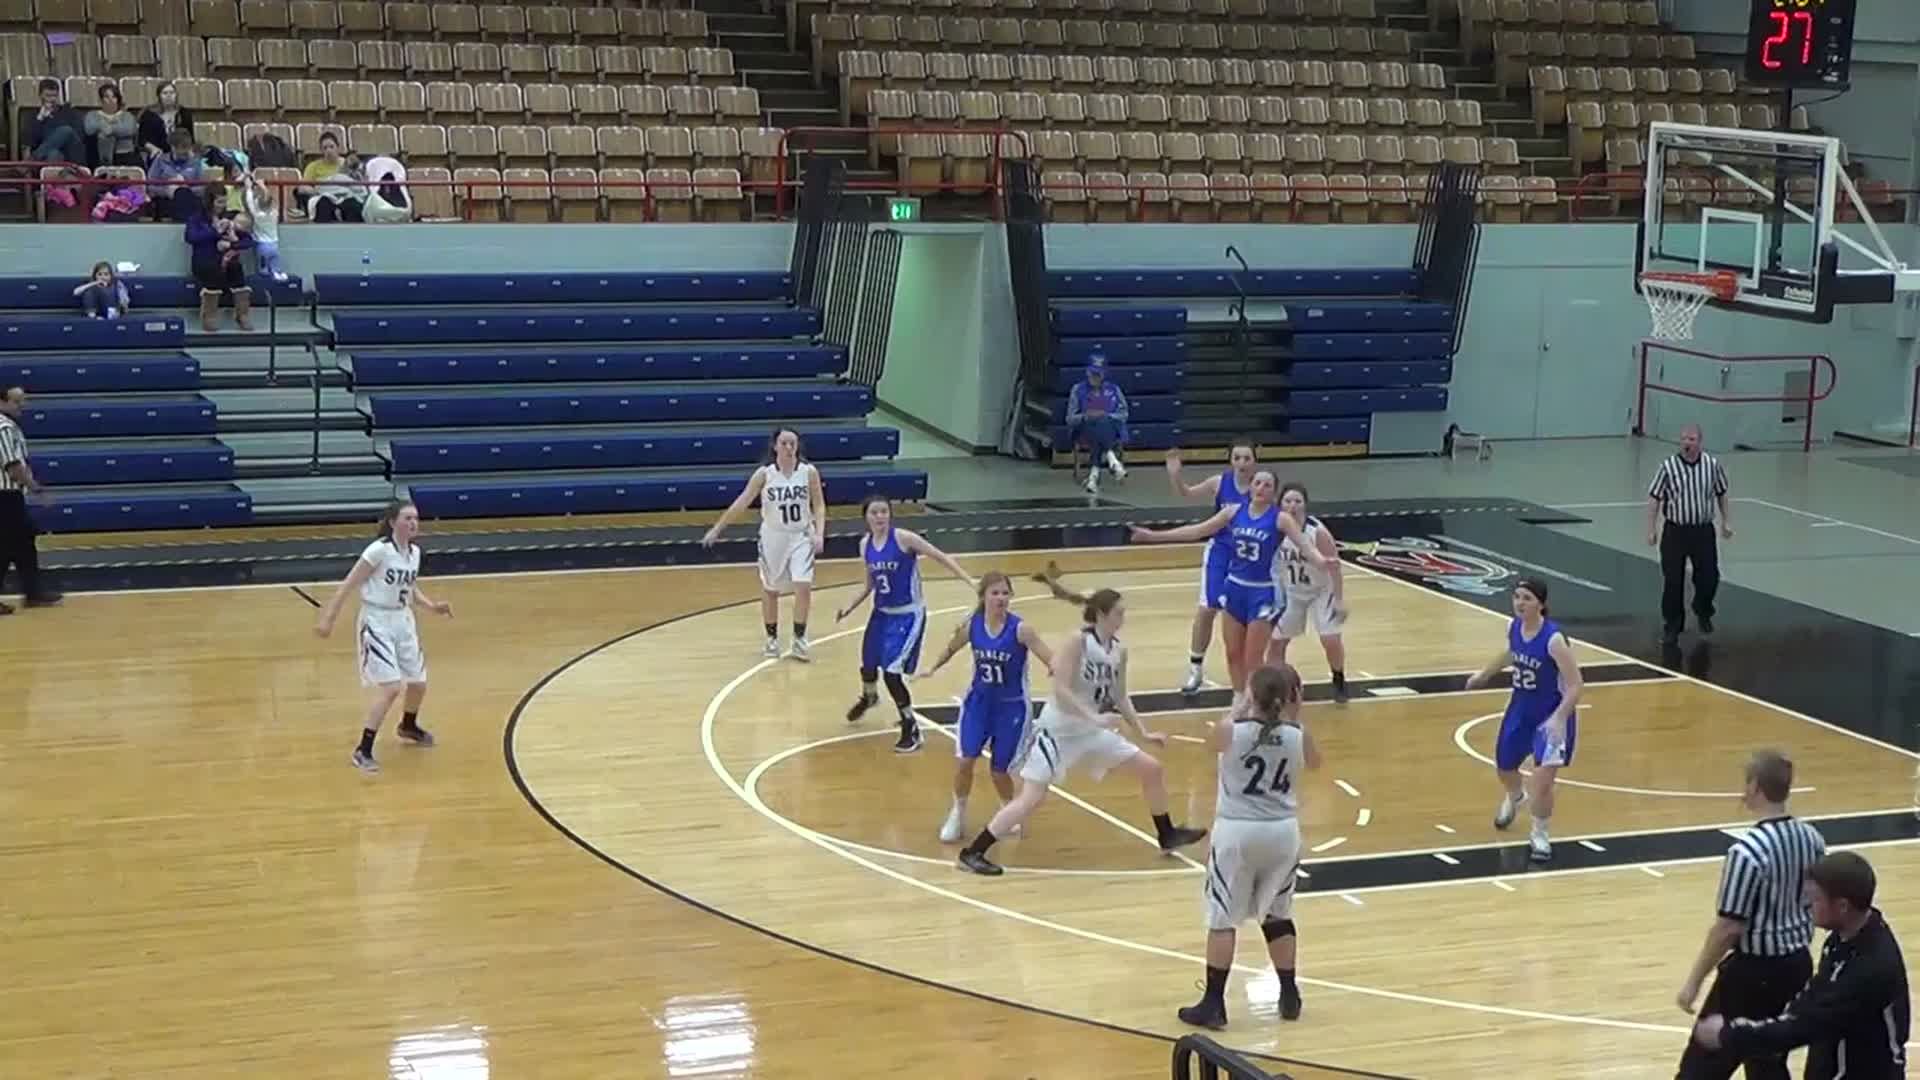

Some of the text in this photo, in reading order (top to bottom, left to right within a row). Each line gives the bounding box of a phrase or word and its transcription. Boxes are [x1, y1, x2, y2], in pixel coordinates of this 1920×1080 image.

[1762, 11, 1813, 68] 27
[767, 485, 808, 501] STARS
[778, 503, 801, 525] 10
[1235, 540, 1260, 562] 23
[876, 574, 891, 594] 3
[1287, 564, 1311, 585] 14
[980, 663, 1003, 683] 31
[1511, 667, 1537, 690] 22
[1242, 755, 1291, 795] 24
